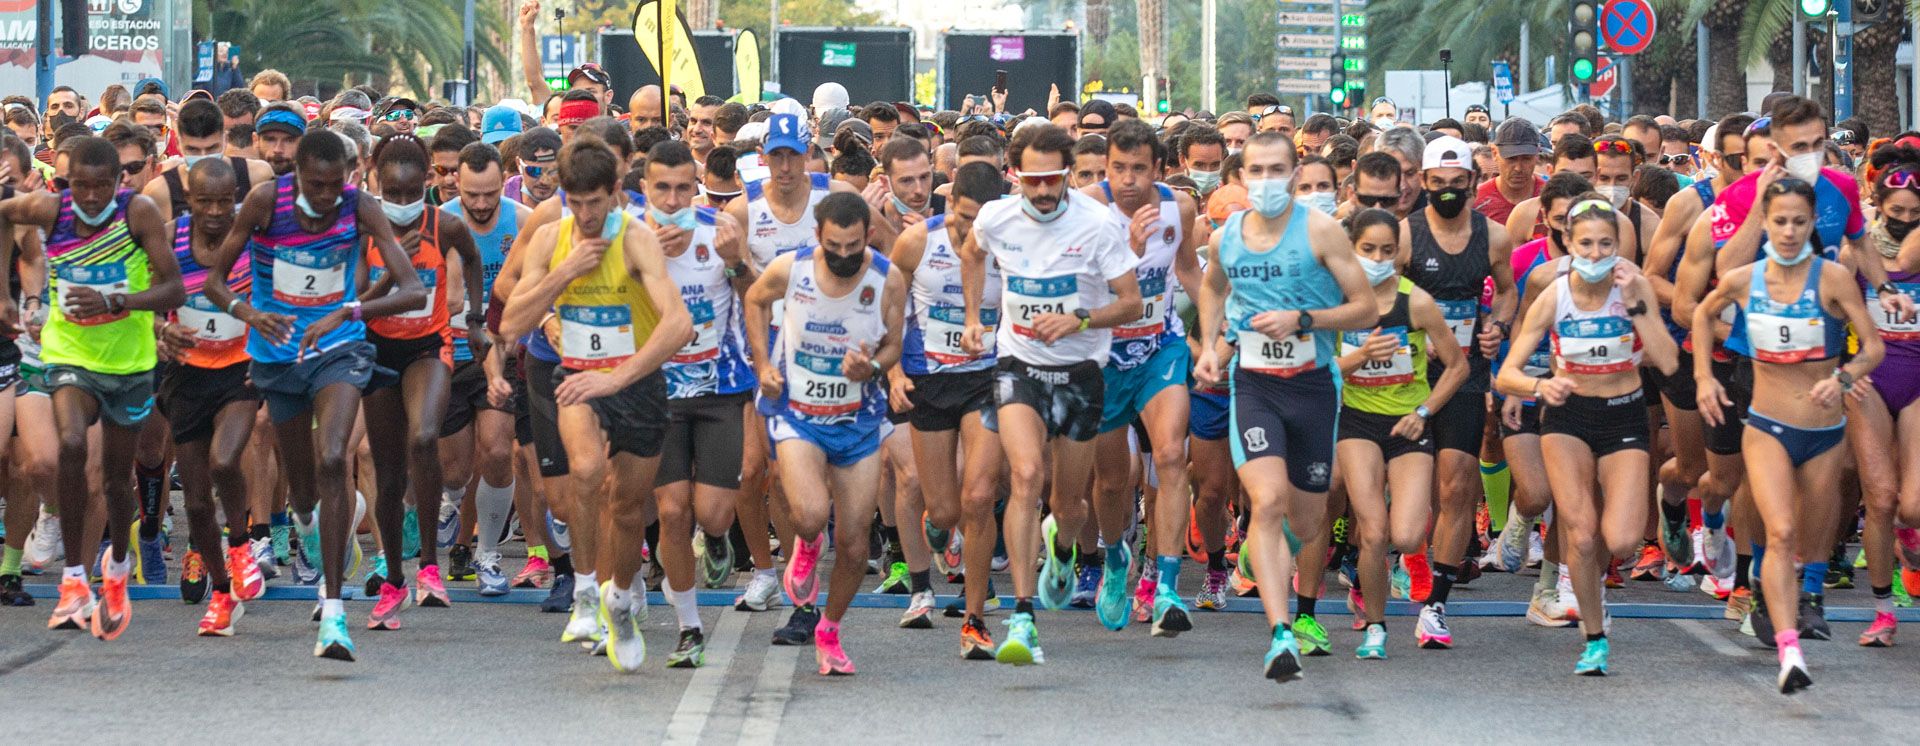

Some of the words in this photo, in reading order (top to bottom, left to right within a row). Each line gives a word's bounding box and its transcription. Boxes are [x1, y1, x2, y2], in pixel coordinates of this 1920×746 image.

[111, 18, 160, 29] ESTACIÓN
[549, 38, 568, 61] P
[1228, 261, 1282, 281] nerja
[305, 274, 316, 290] 2
[206, 318, 217, 334] 4
[1780, 325, 1790, 343] 9
[590, 333, 601, 350] 8
[1262, 341, 1294, 359] 462
[1588, 345, 1607, 357] 10
[805, 380, 848, 399] 2510
[1607, 395, 1630, 406] NIKE
